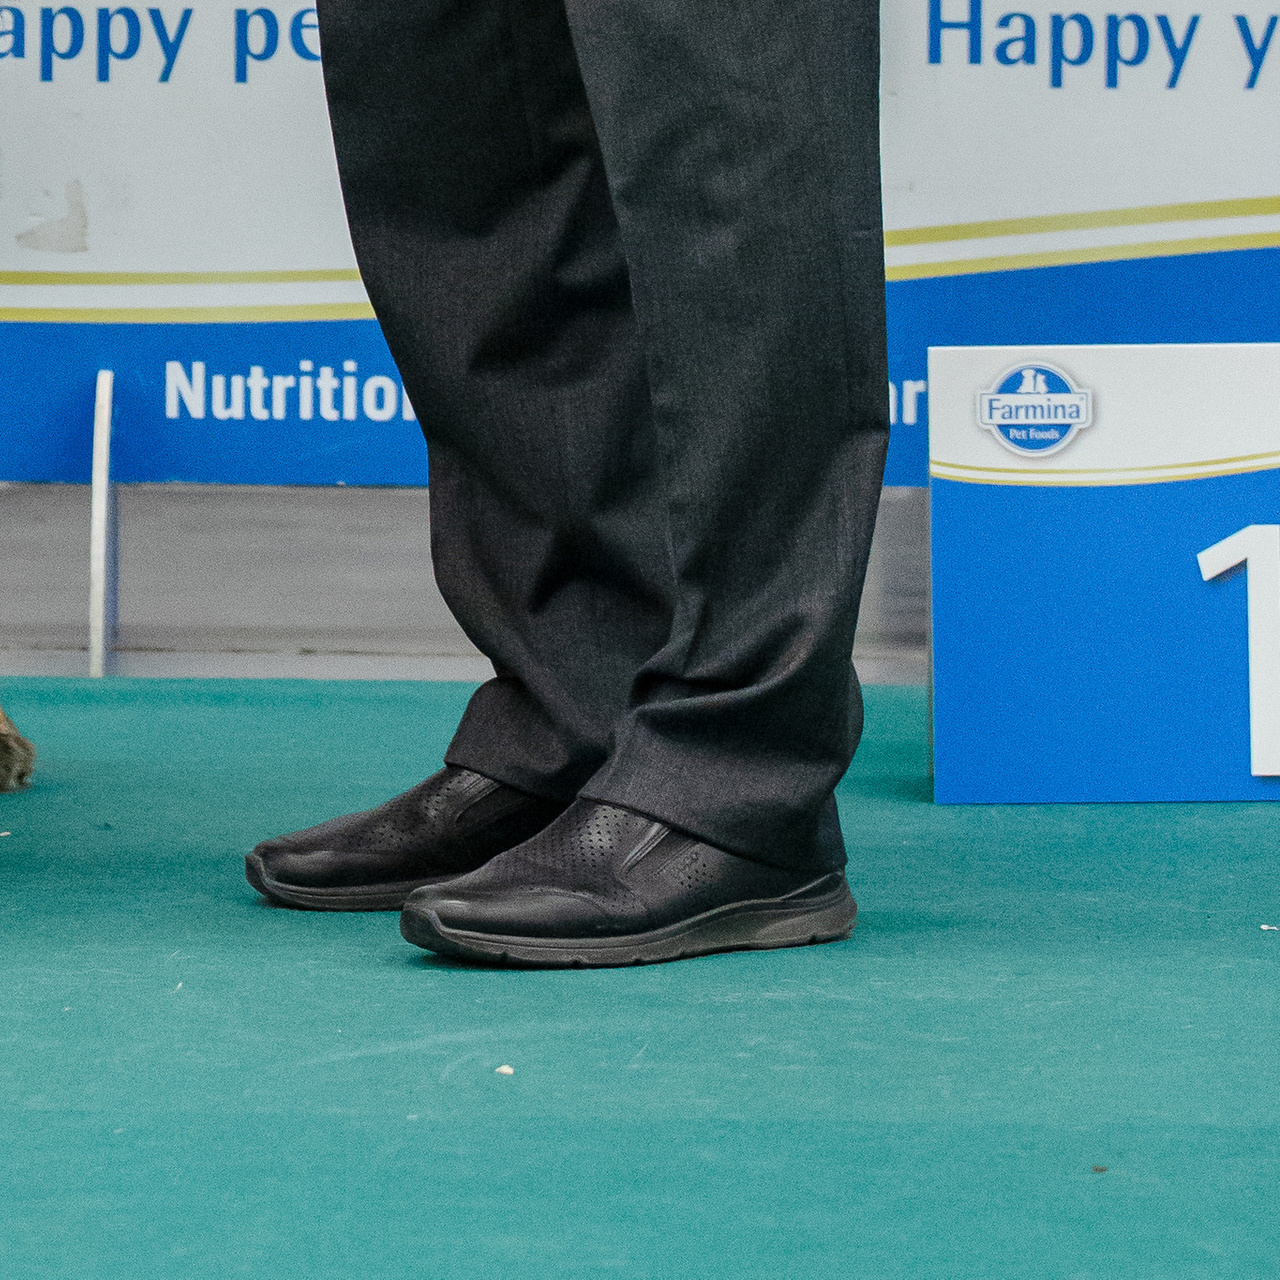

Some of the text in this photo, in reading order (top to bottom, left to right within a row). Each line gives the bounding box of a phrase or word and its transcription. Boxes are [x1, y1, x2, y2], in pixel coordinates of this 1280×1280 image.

[234, 6, 321, 83] pe
[1234, 14, 1280, 89] y
[988, 398, 1081, 420] Farmina
[1009, 428, 1060, 440] Pet Foods
[1196, 524, 1280, 776] 1
